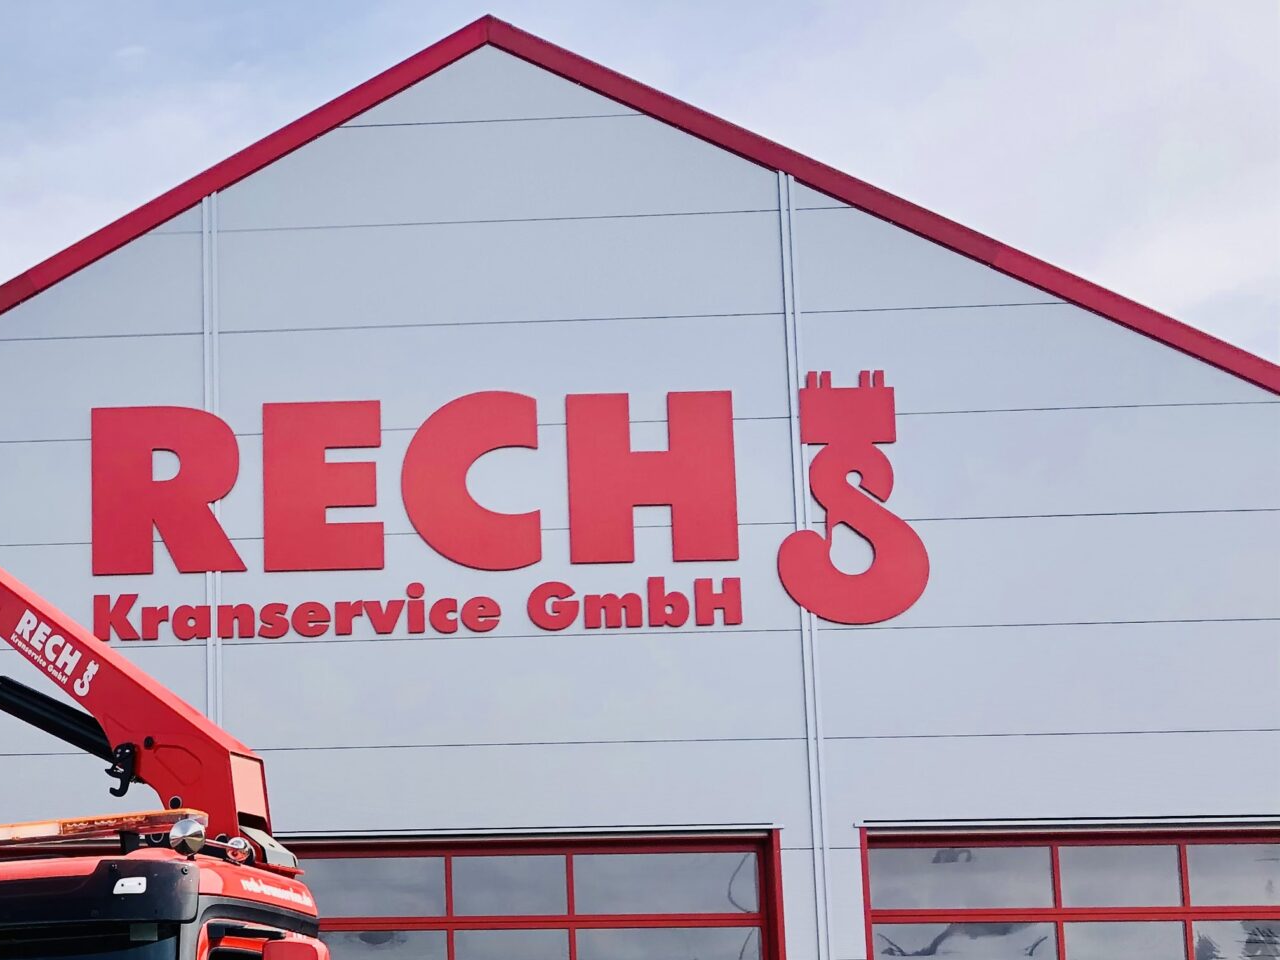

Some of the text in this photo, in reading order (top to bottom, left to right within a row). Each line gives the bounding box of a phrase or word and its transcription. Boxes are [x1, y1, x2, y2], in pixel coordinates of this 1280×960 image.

[91, 390, 739, 575] RECH
[14, 608, 82, 676] RECH
[93, 577, 743, 641] Kranservice GmbH
[10, 633, 68, 685] Kranservice GmbH
